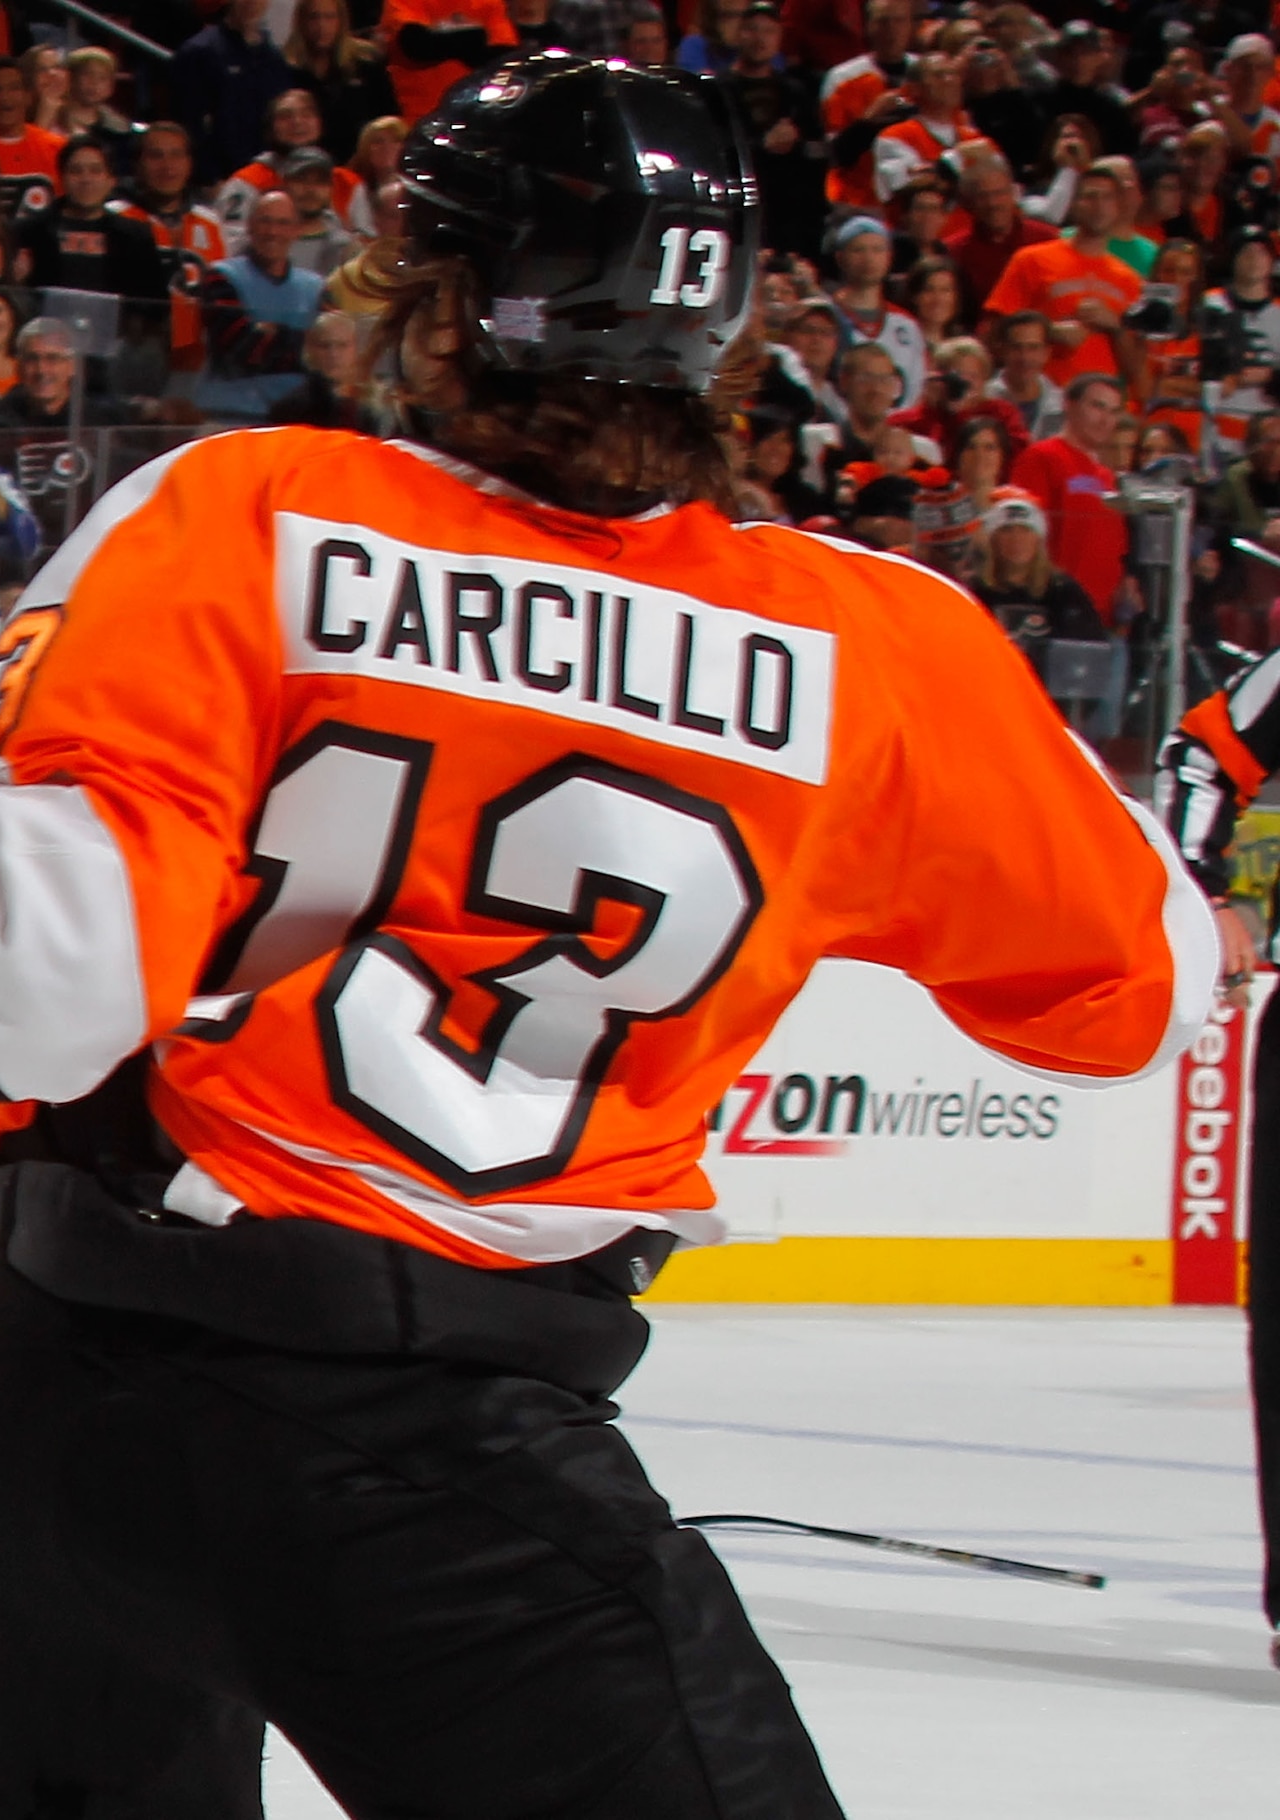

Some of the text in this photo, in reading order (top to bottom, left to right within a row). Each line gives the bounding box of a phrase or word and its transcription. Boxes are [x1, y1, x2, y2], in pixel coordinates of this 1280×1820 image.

[649, 226, 731, 308] 13
[304, 537, 794, 752] CARCILLO
[180, 719, 766, 1207] 13
[870, 1078, 1059, 1139] wireless
